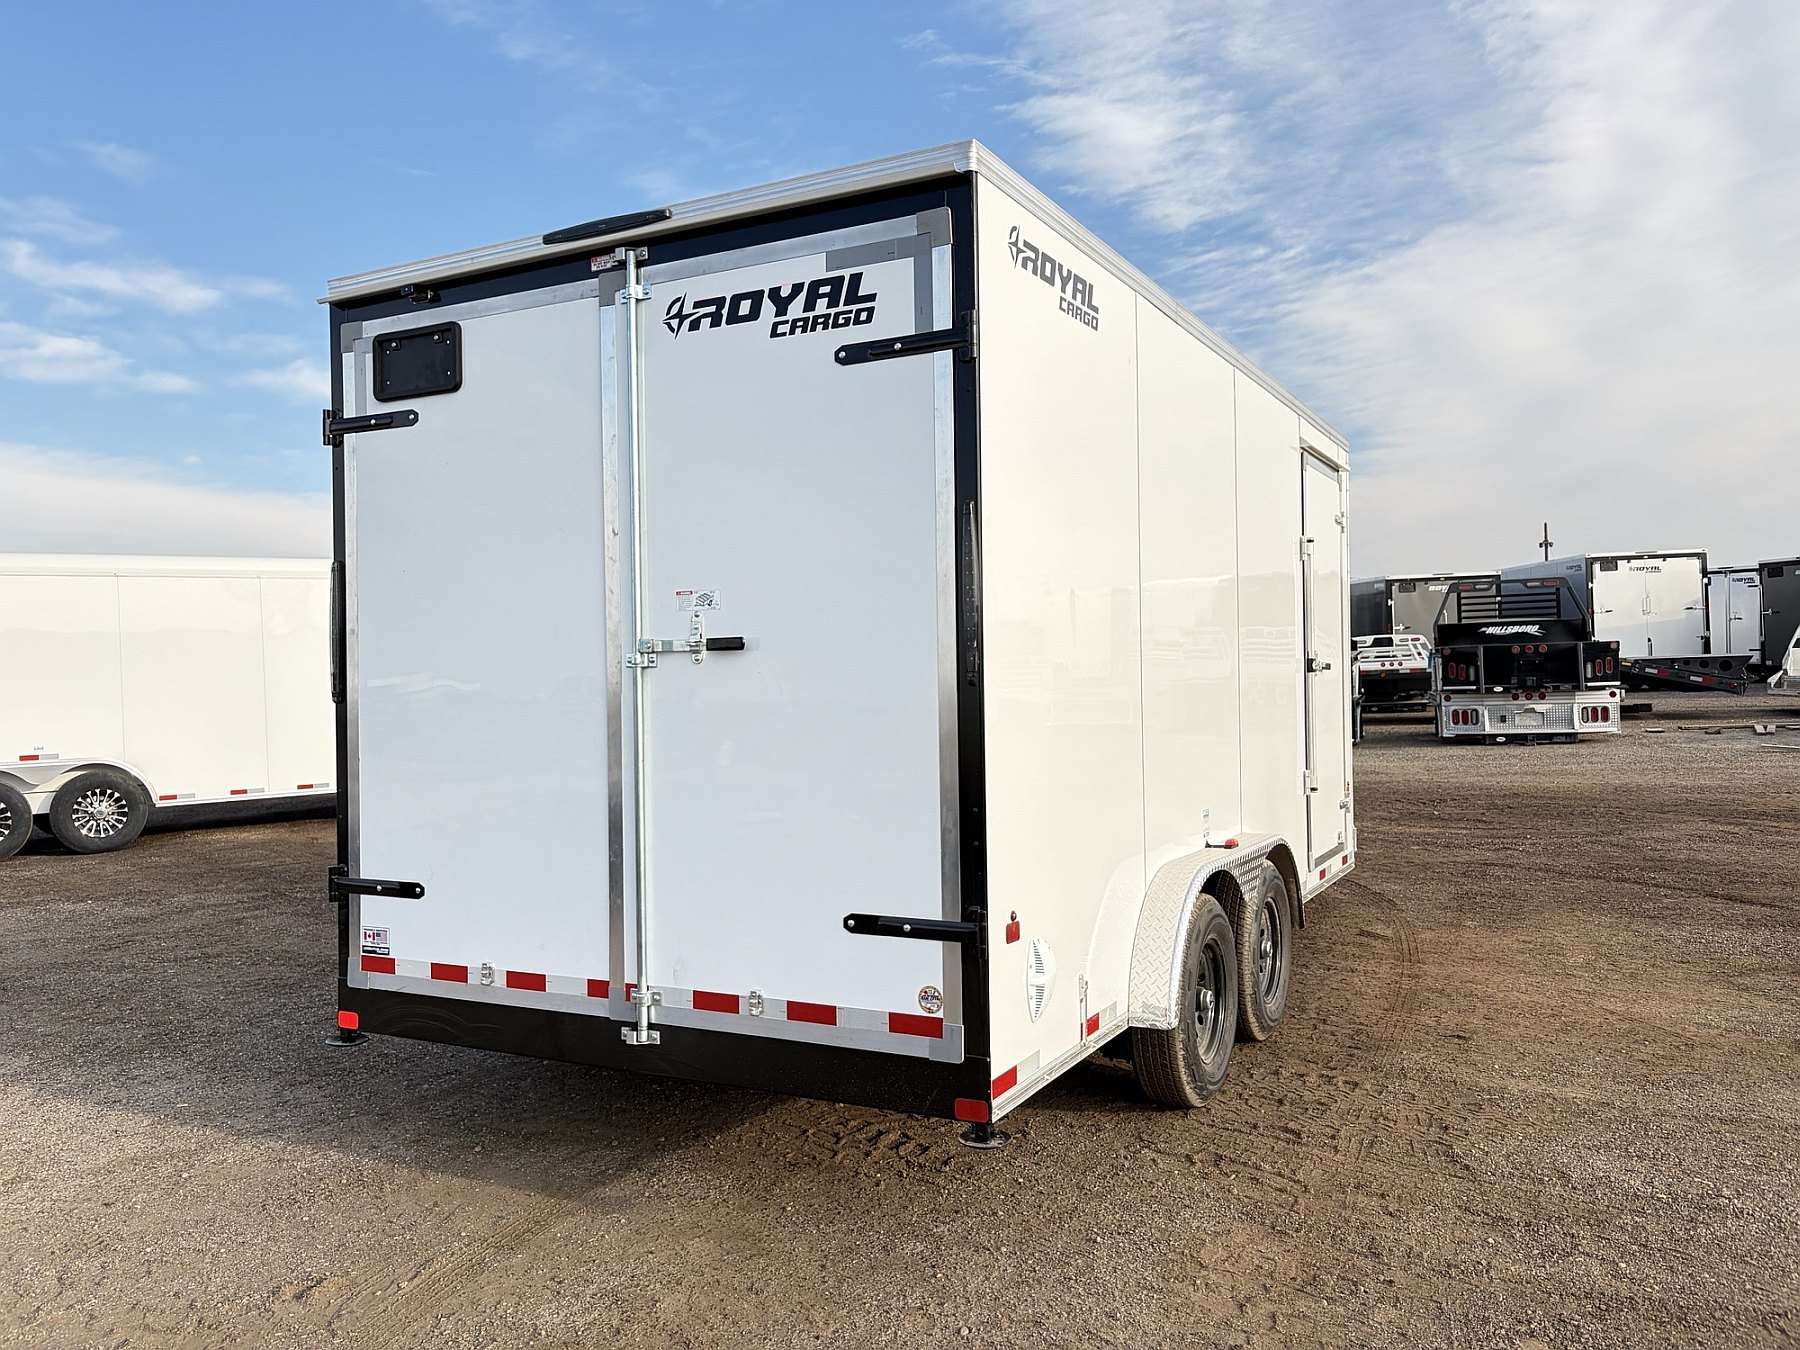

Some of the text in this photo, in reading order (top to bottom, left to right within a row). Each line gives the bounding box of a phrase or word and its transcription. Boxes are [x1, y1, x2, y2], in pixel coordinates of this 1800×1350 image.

[1021, 239, 1099, 315] ROYAL
[687, 271, 877, 333] ROYAL
[1059, 295, 1099, 332] CARGO
[769, 306, 876, 339] CARGO
[1485, 624, 1540, 634] HILLSBORO
